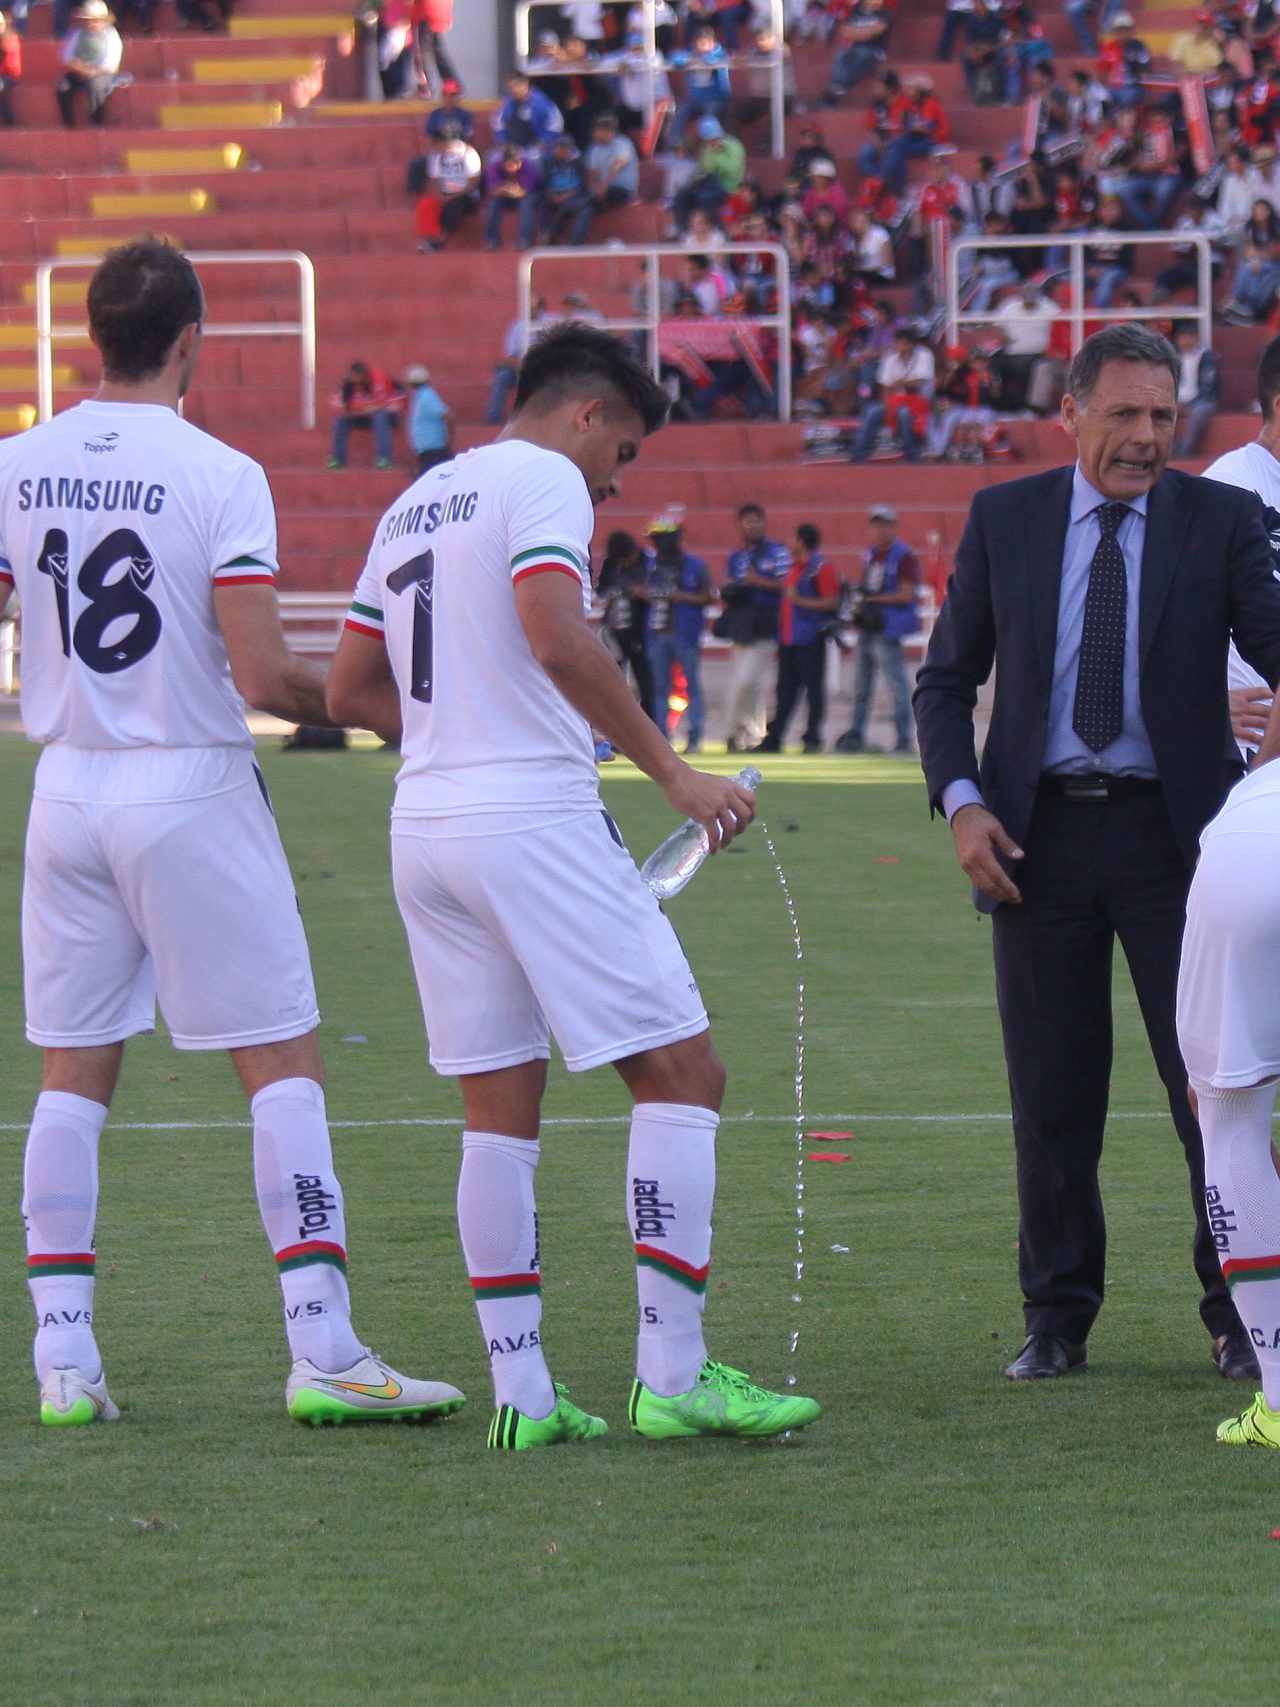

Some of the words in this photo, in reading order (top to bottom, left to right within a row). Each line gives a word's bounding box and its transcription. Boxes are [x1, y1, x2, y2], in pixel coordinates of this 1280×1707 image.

[83, 442, 118, 454] Topper
[18, 477, 166, 515] SAMSUNG
[37, 527, 163, 674] 18
[293, 1173, 336, 1239] Topper
[633, 1177, 676, 1241] Topper
